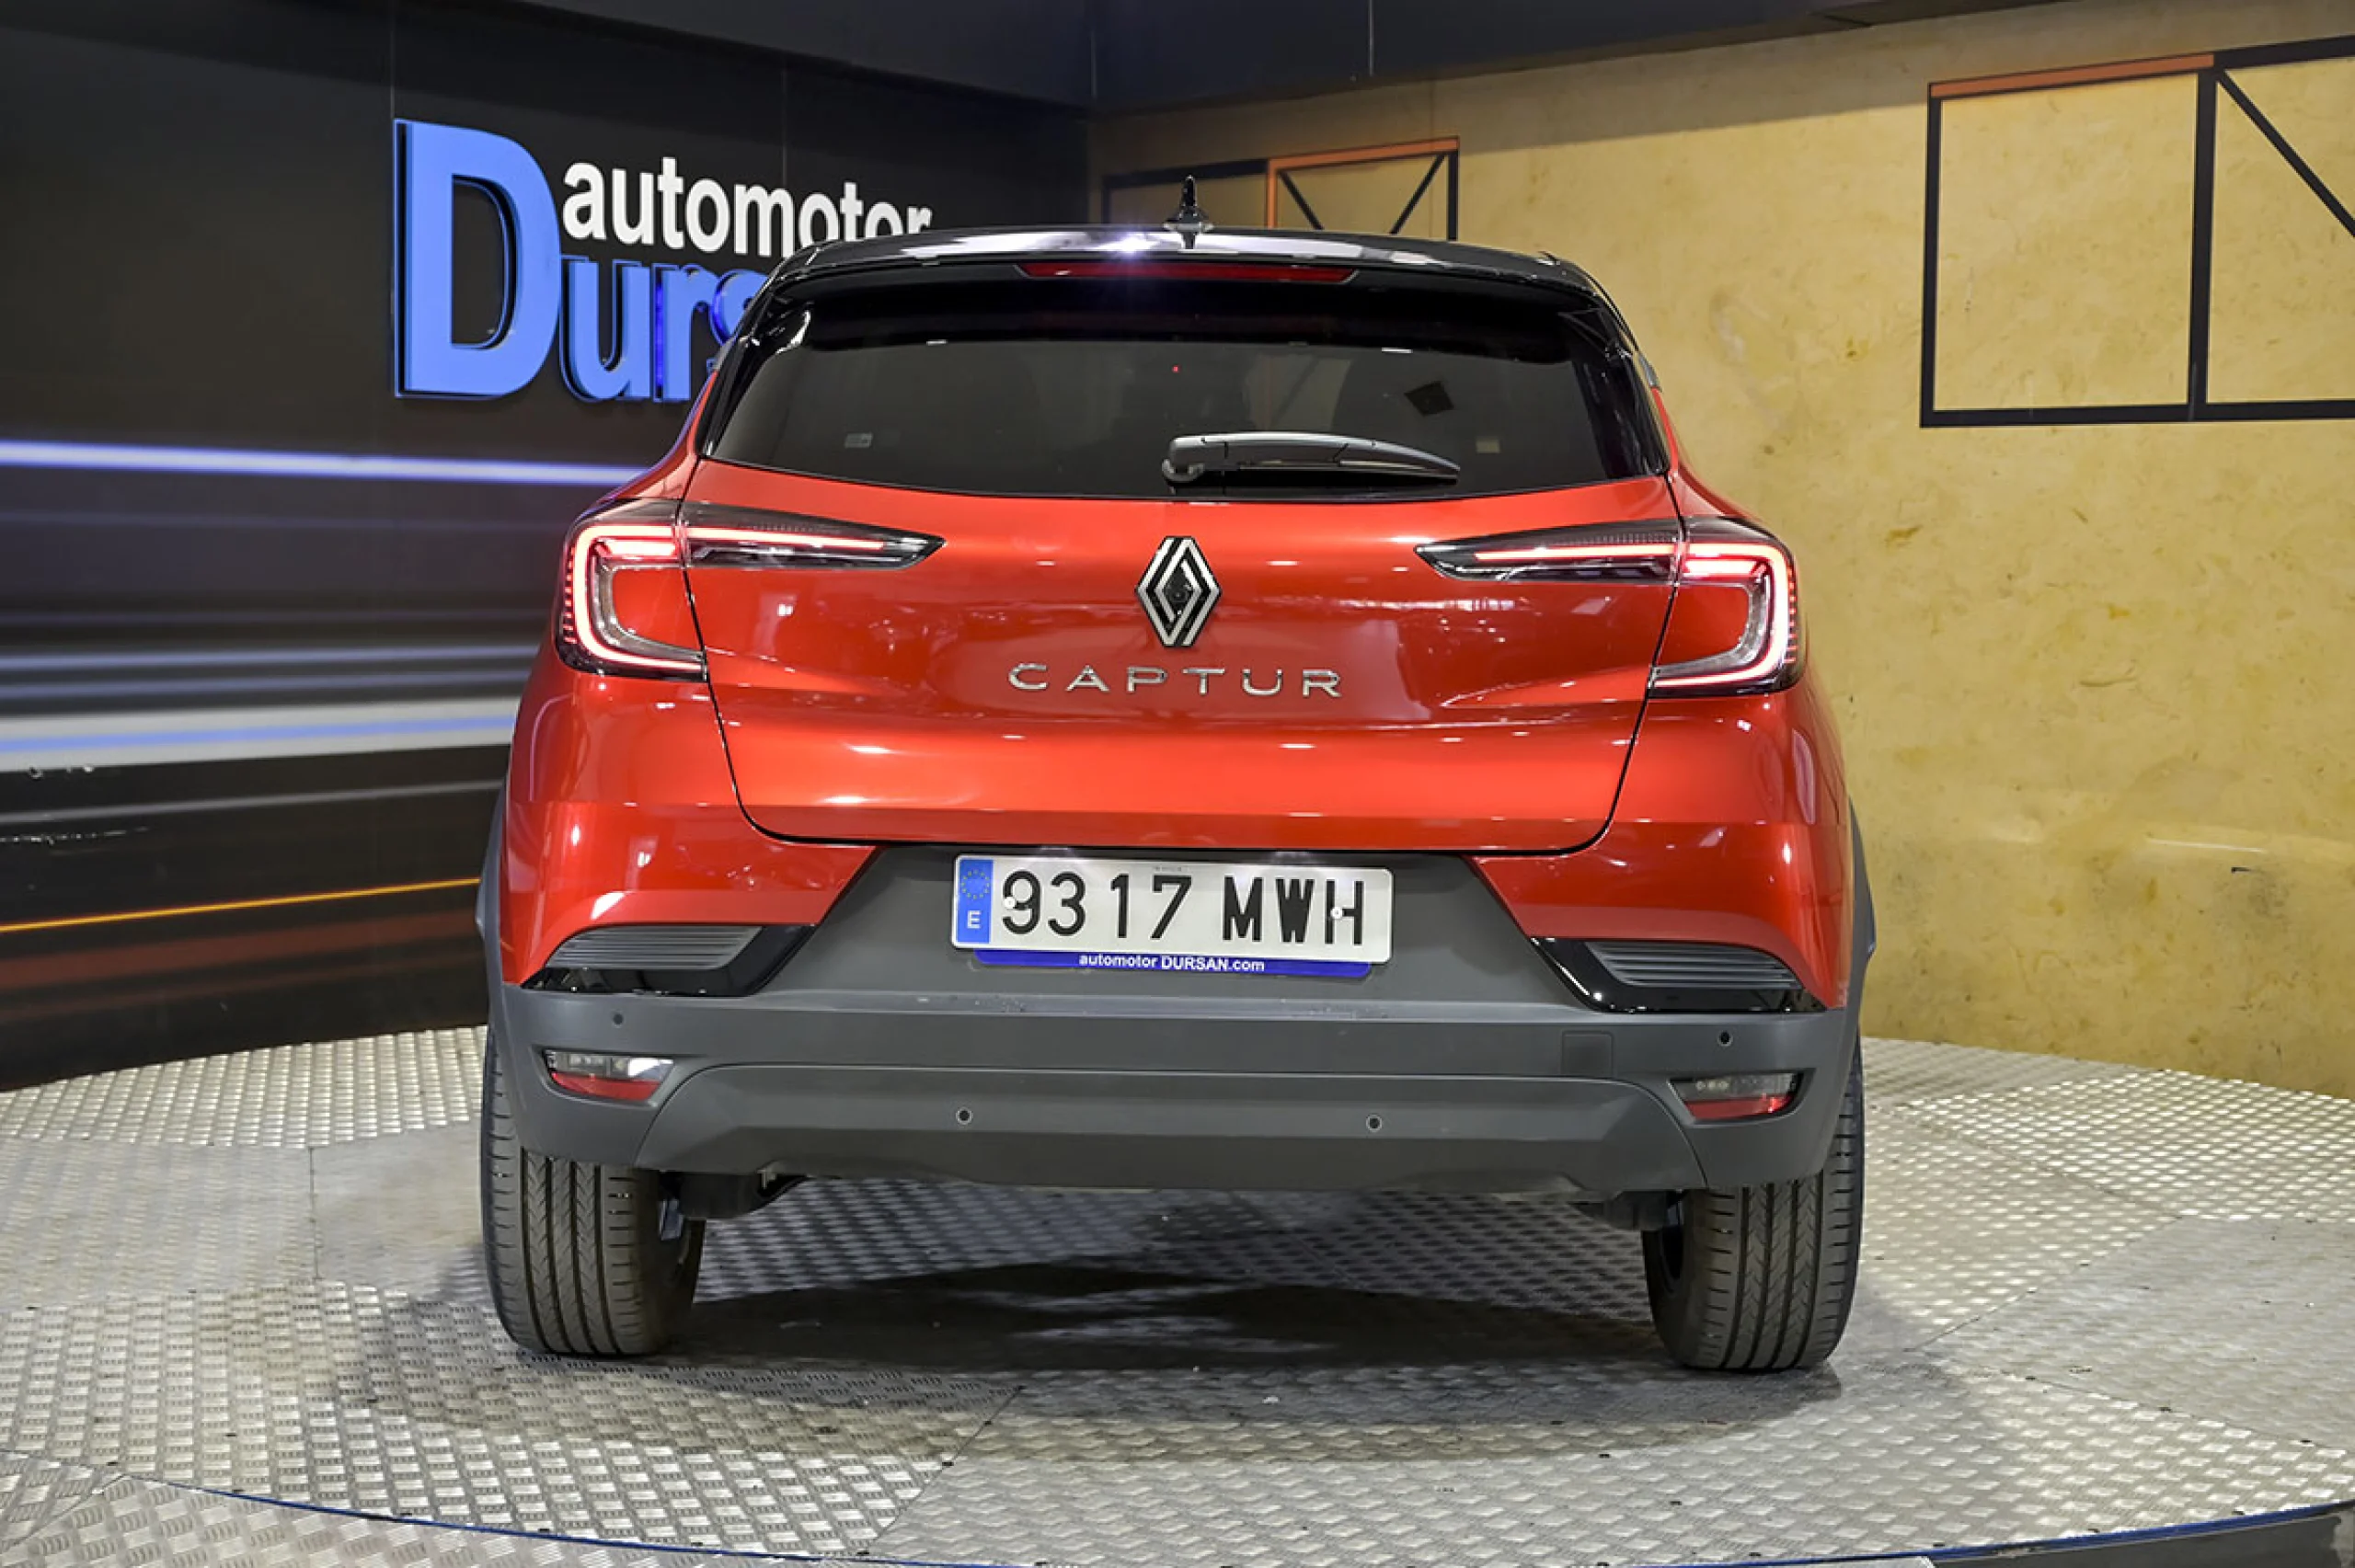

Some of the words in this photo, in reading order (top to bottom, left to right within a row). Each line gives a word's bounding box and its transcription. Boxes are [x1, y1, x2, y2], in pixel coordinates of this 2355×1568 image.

[1008, 662, 1342, 698] CAPTUR
[966, 910, 982, 929] E
[1002, 870, 1193, 940] 9317
[1223, 876, 1364, 945] MWH
[1079, 954, 1158, 968] automotor
[1161, 955, 1265, 972] DURSAN.com
